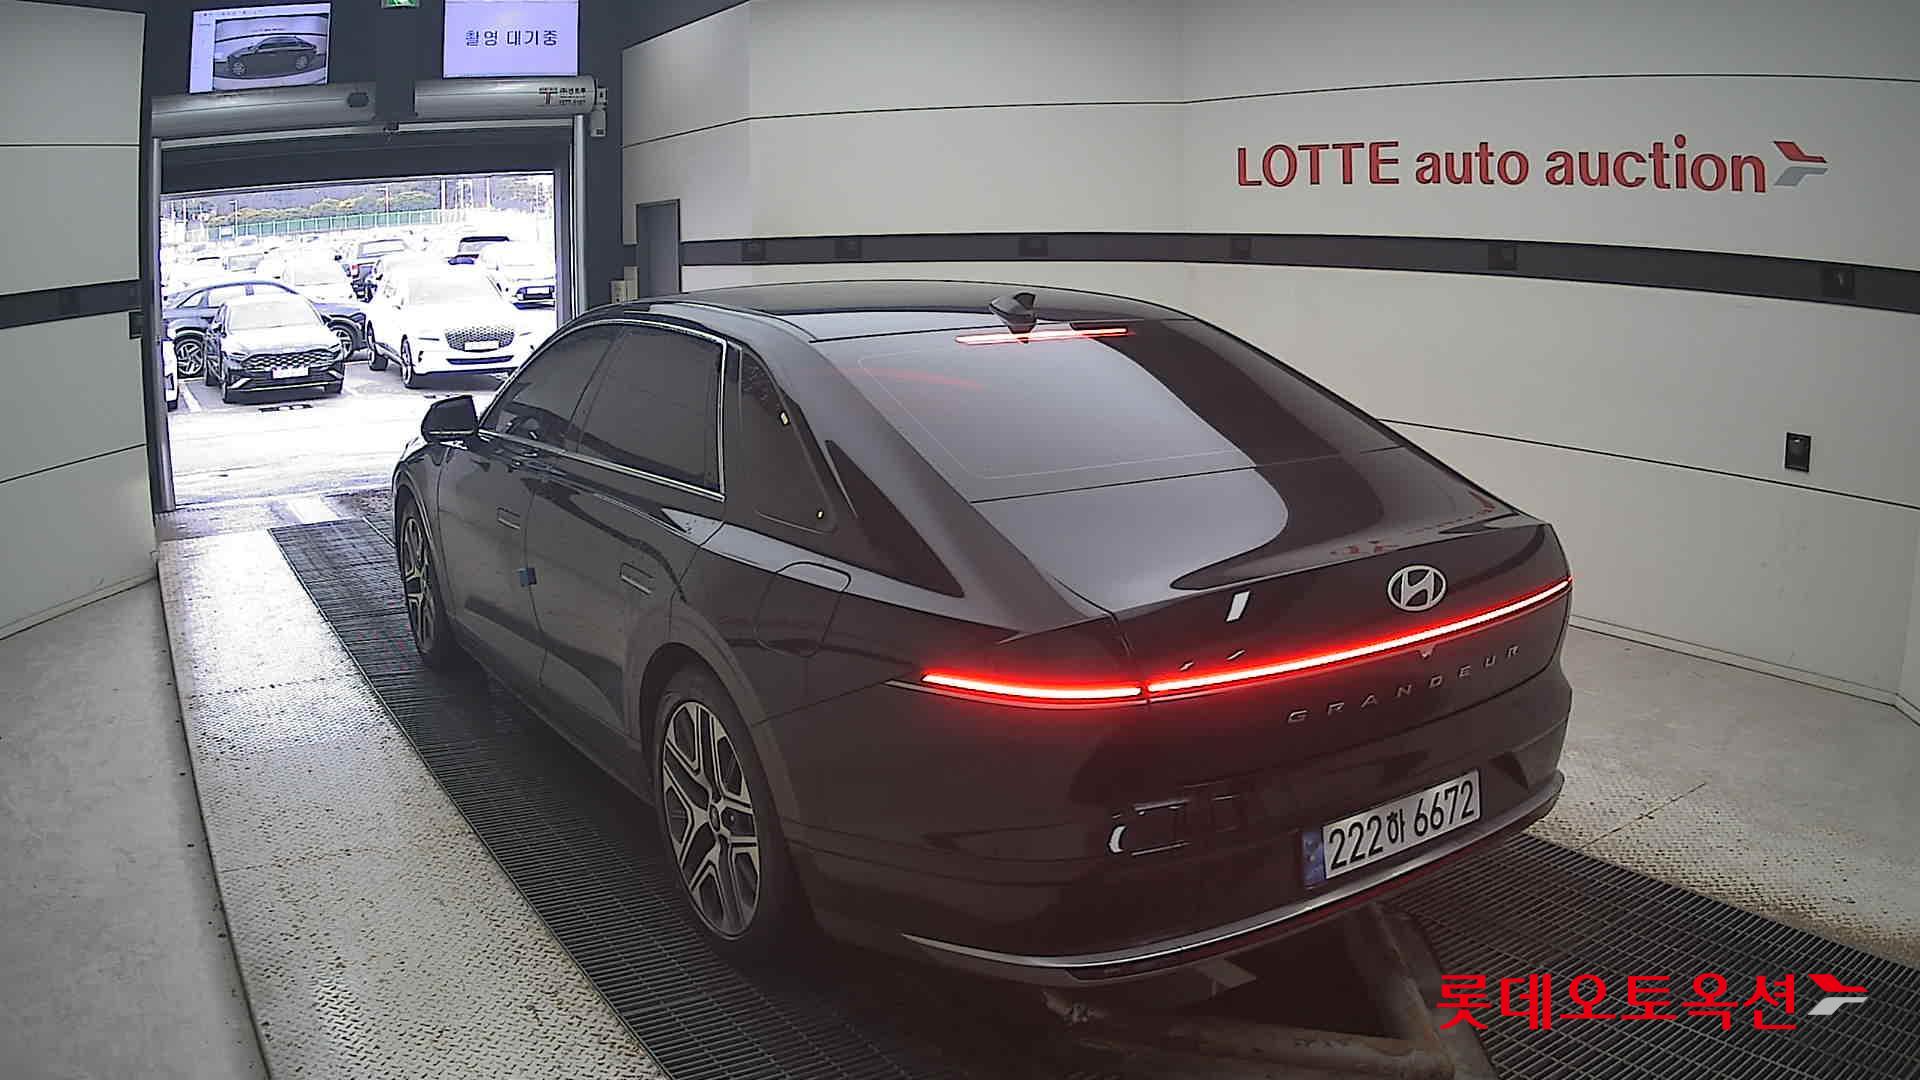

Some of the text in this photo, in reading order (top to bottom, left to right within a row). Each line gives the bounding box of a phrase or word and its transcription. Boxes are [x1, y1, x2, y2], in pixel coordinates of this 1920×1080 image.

[465, 30, 558, 47] 촬영 대기중
[1237, 134, 1768, 194] LOTTE auto auction
[1287, 644, 1521, 724] GRANDEUR
[1329, 780, 1475, 871] 222하 6672
